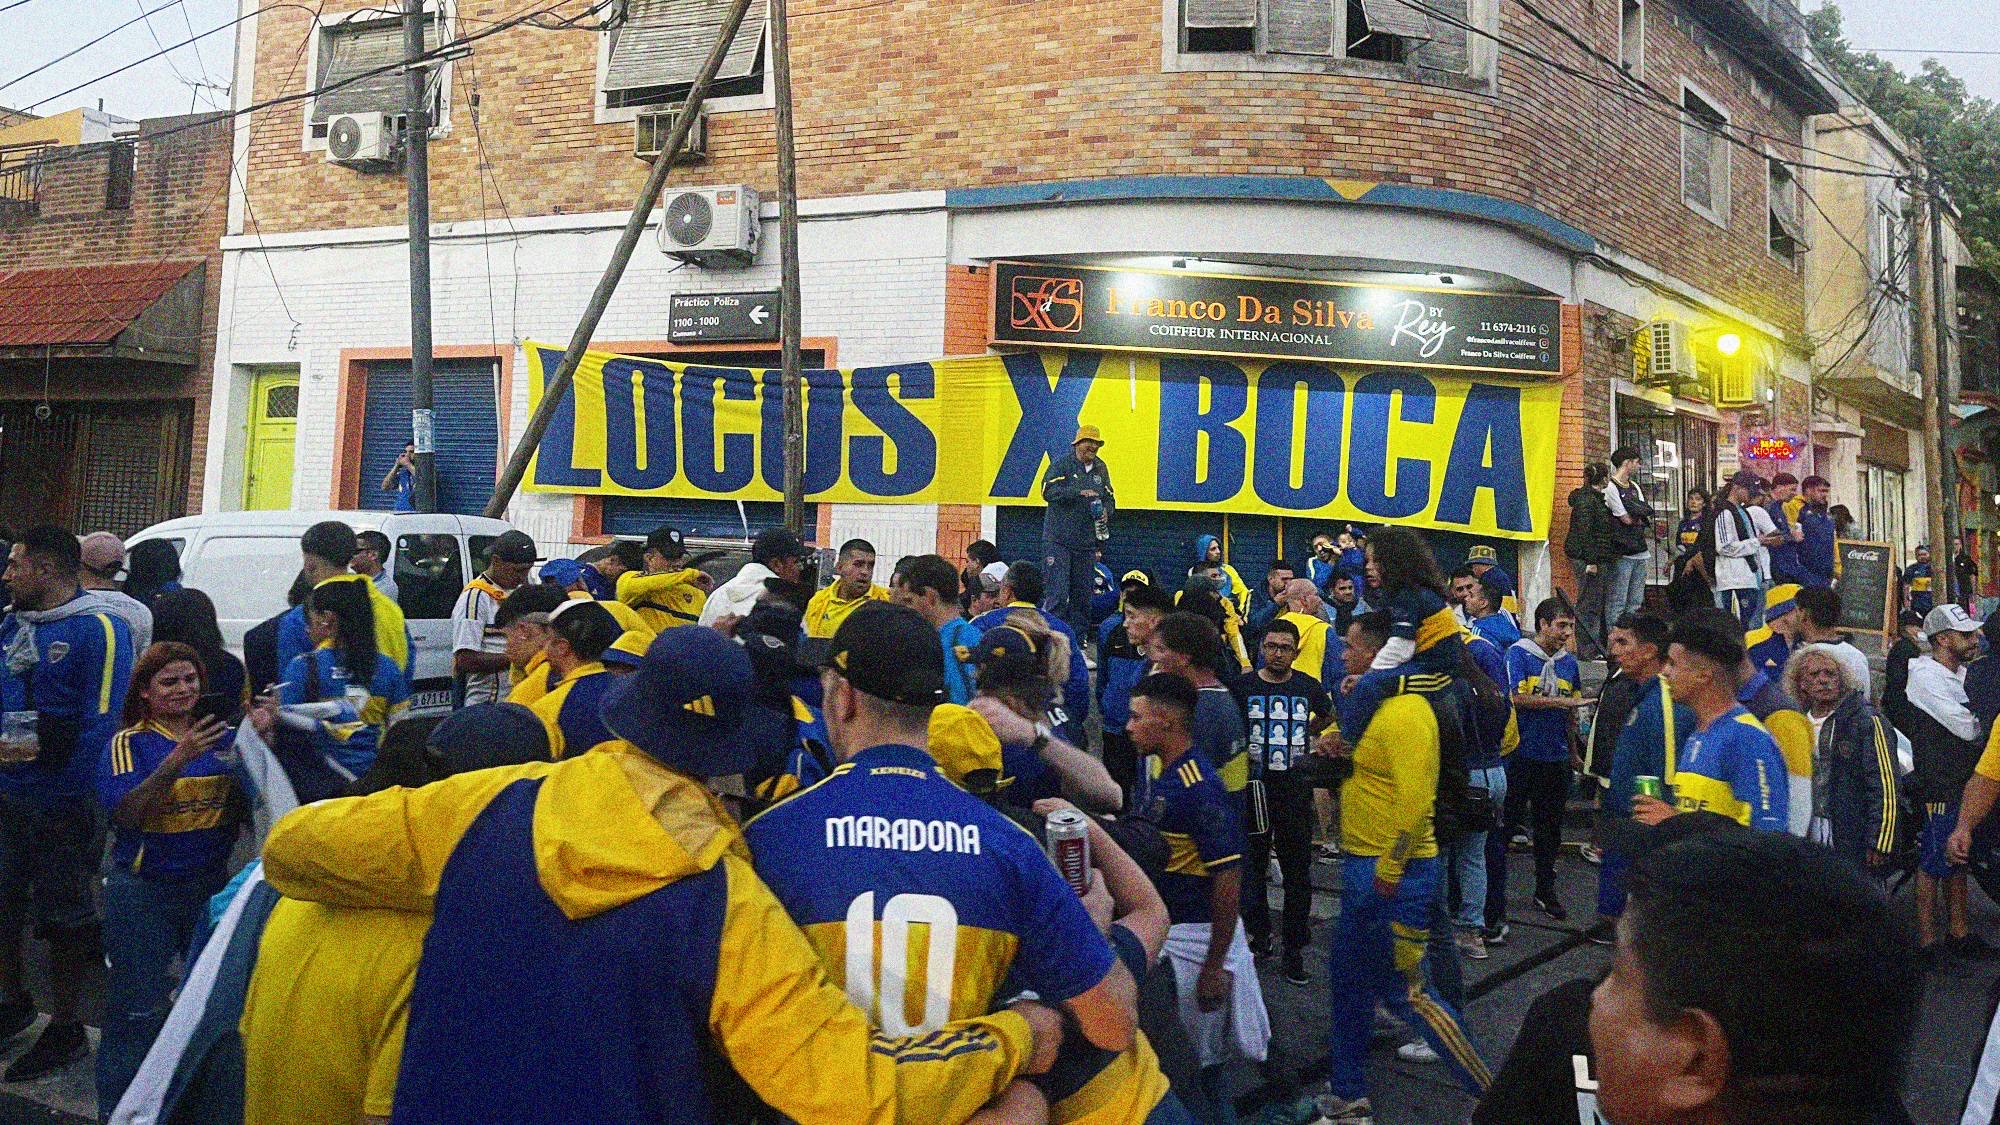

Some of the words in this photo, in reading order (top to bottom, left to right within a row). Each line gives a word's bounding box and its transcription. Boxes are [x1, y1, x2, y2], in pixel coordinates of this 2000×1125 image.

[675, 298, 709, 307] Práctico
[1429, 307, 1444, 318] BY
[674, 318, 693, 327] 1100
[699, 317, 720, 326] 1000
[1237, 296, 1282, 324] Da
[1292, 299, 1375, 330] Silva
[1150, 325, 1215, 339] COIFFEUR
[1220, 329, 1332, 345] INTERNACIONAL
[1391, 299, 1455, 358] Rey
[1480, 322, 1491, 332] 11
[1493, 323, 1537, 334] 6374-2116
[1460, 349, 1482, 357] Franco
[1493, 351, 1509, 359] Silva
[1510, 352, 1536, 360] Coiffeur
[534, 347, 937, 497] LOCOS
[989, 351, 1101, 498] X
[1156, 360, 1532, 533] BOCA
[825, 815, 981, 855] MARADONA
[845, 890, 958, 1038] 10
